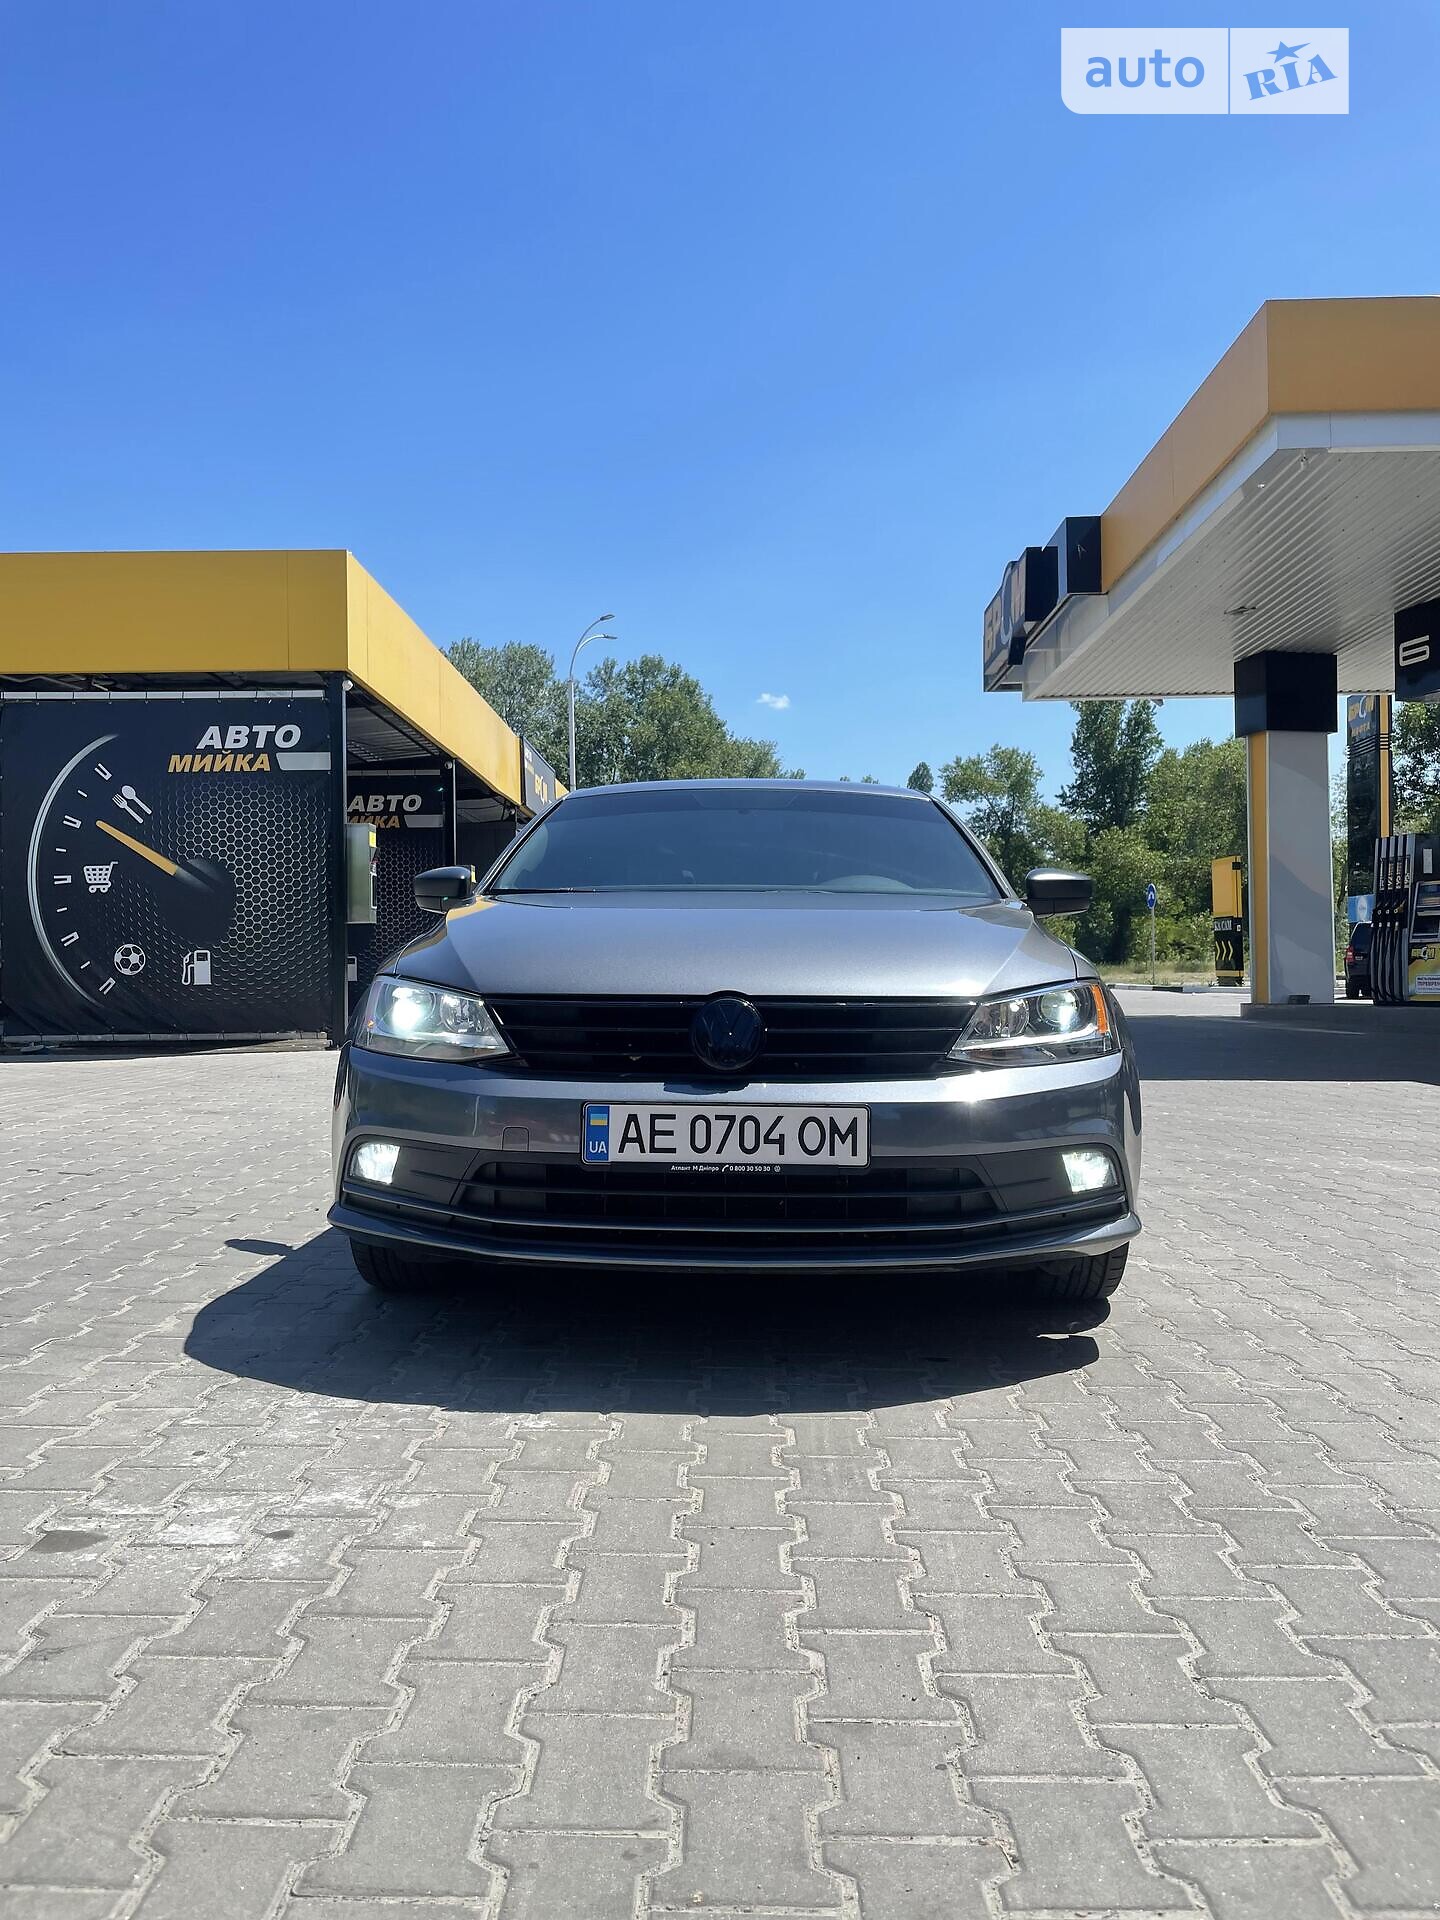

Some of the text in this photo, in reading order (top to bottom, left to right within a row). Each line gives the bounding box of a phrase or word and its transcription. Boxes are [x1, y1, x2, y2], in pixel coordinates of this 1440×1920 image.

[1399, 635, 1430, 667] 6
[196, 724, 301, 749] АВТО
[168, 750, 270, 772] МИЙКА
[347, 794, 422, 812] АВТО
[589, 1141, 607, 1153] UA
[618, 1114, 858, 1157] AE 0704 OM
